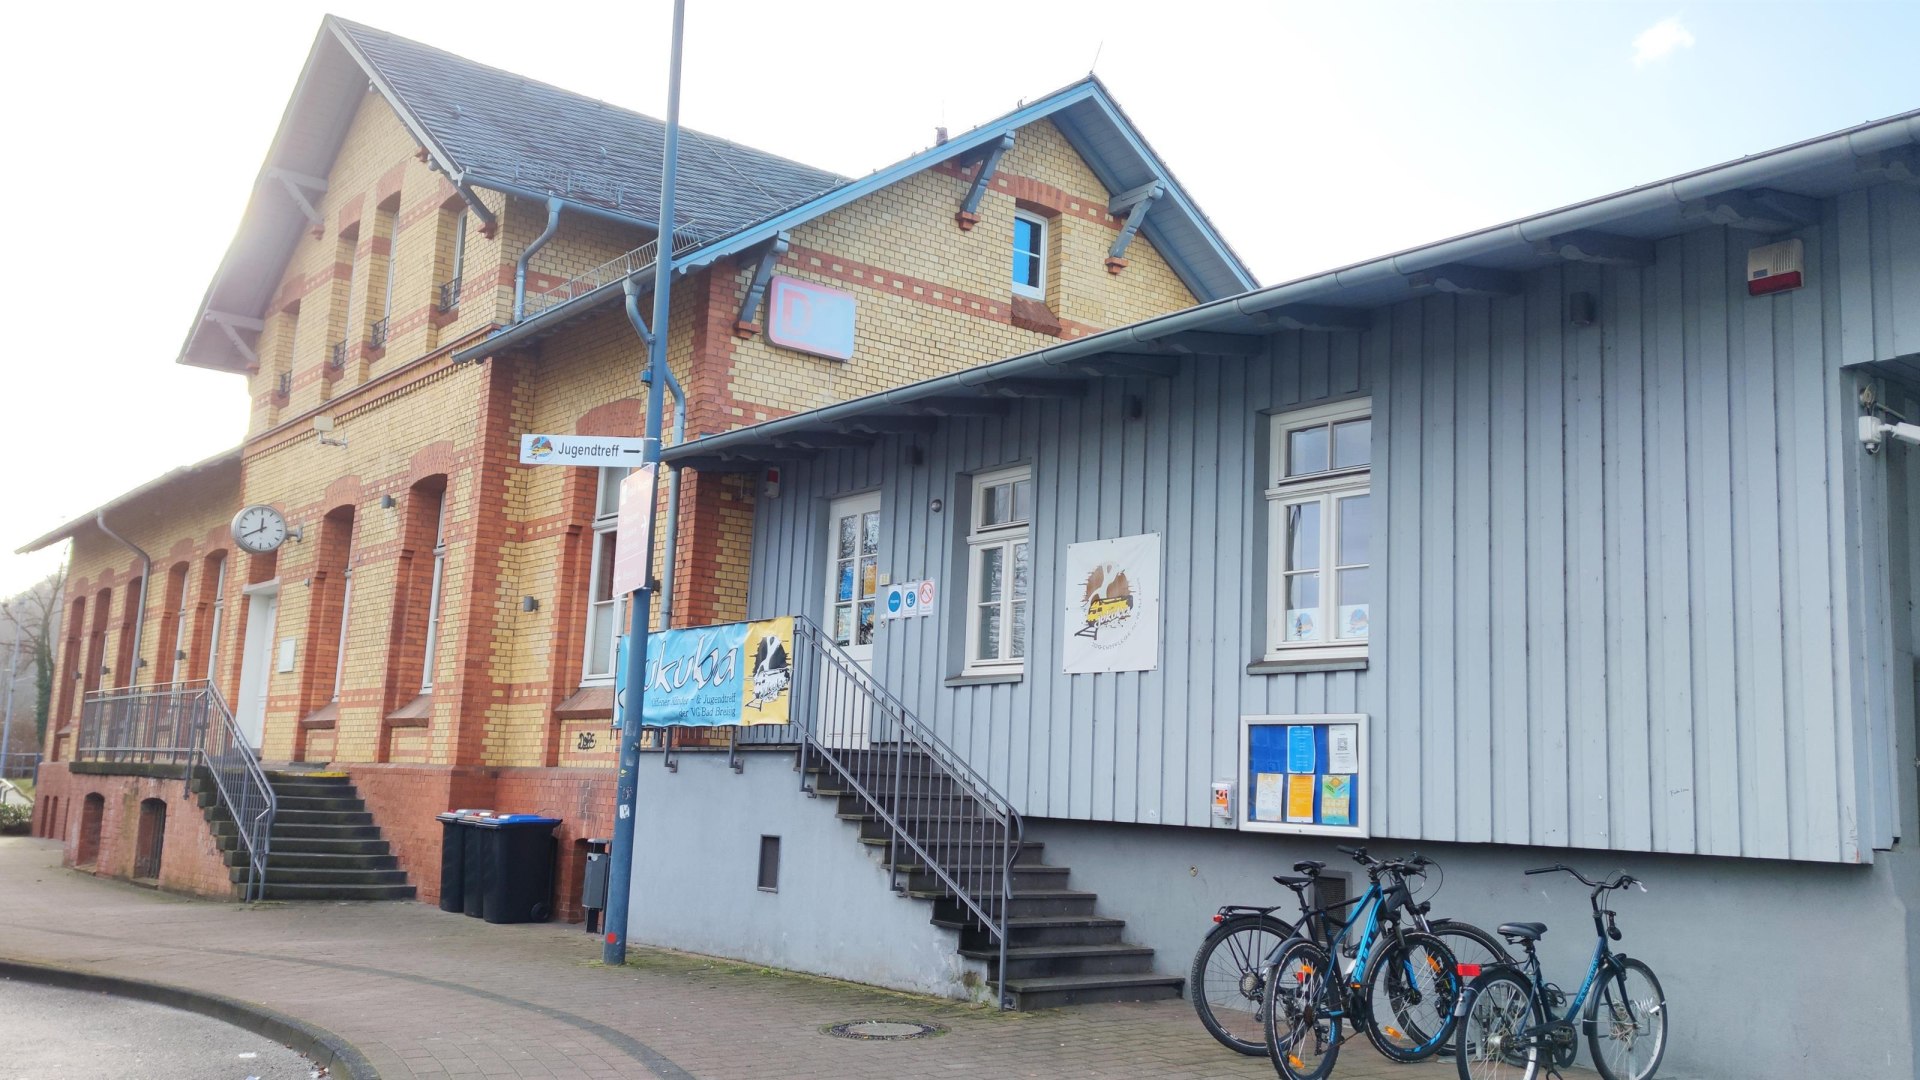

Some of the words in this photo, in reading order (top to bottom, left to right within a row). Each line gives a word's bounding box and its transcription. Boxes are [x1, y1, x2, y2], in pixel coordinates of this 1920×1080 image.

[558, 442, 619, 458] Jugendtreff
[618, 634, 739, 709] ukuba
[703, 693, 736, 705] Jugendtreff
